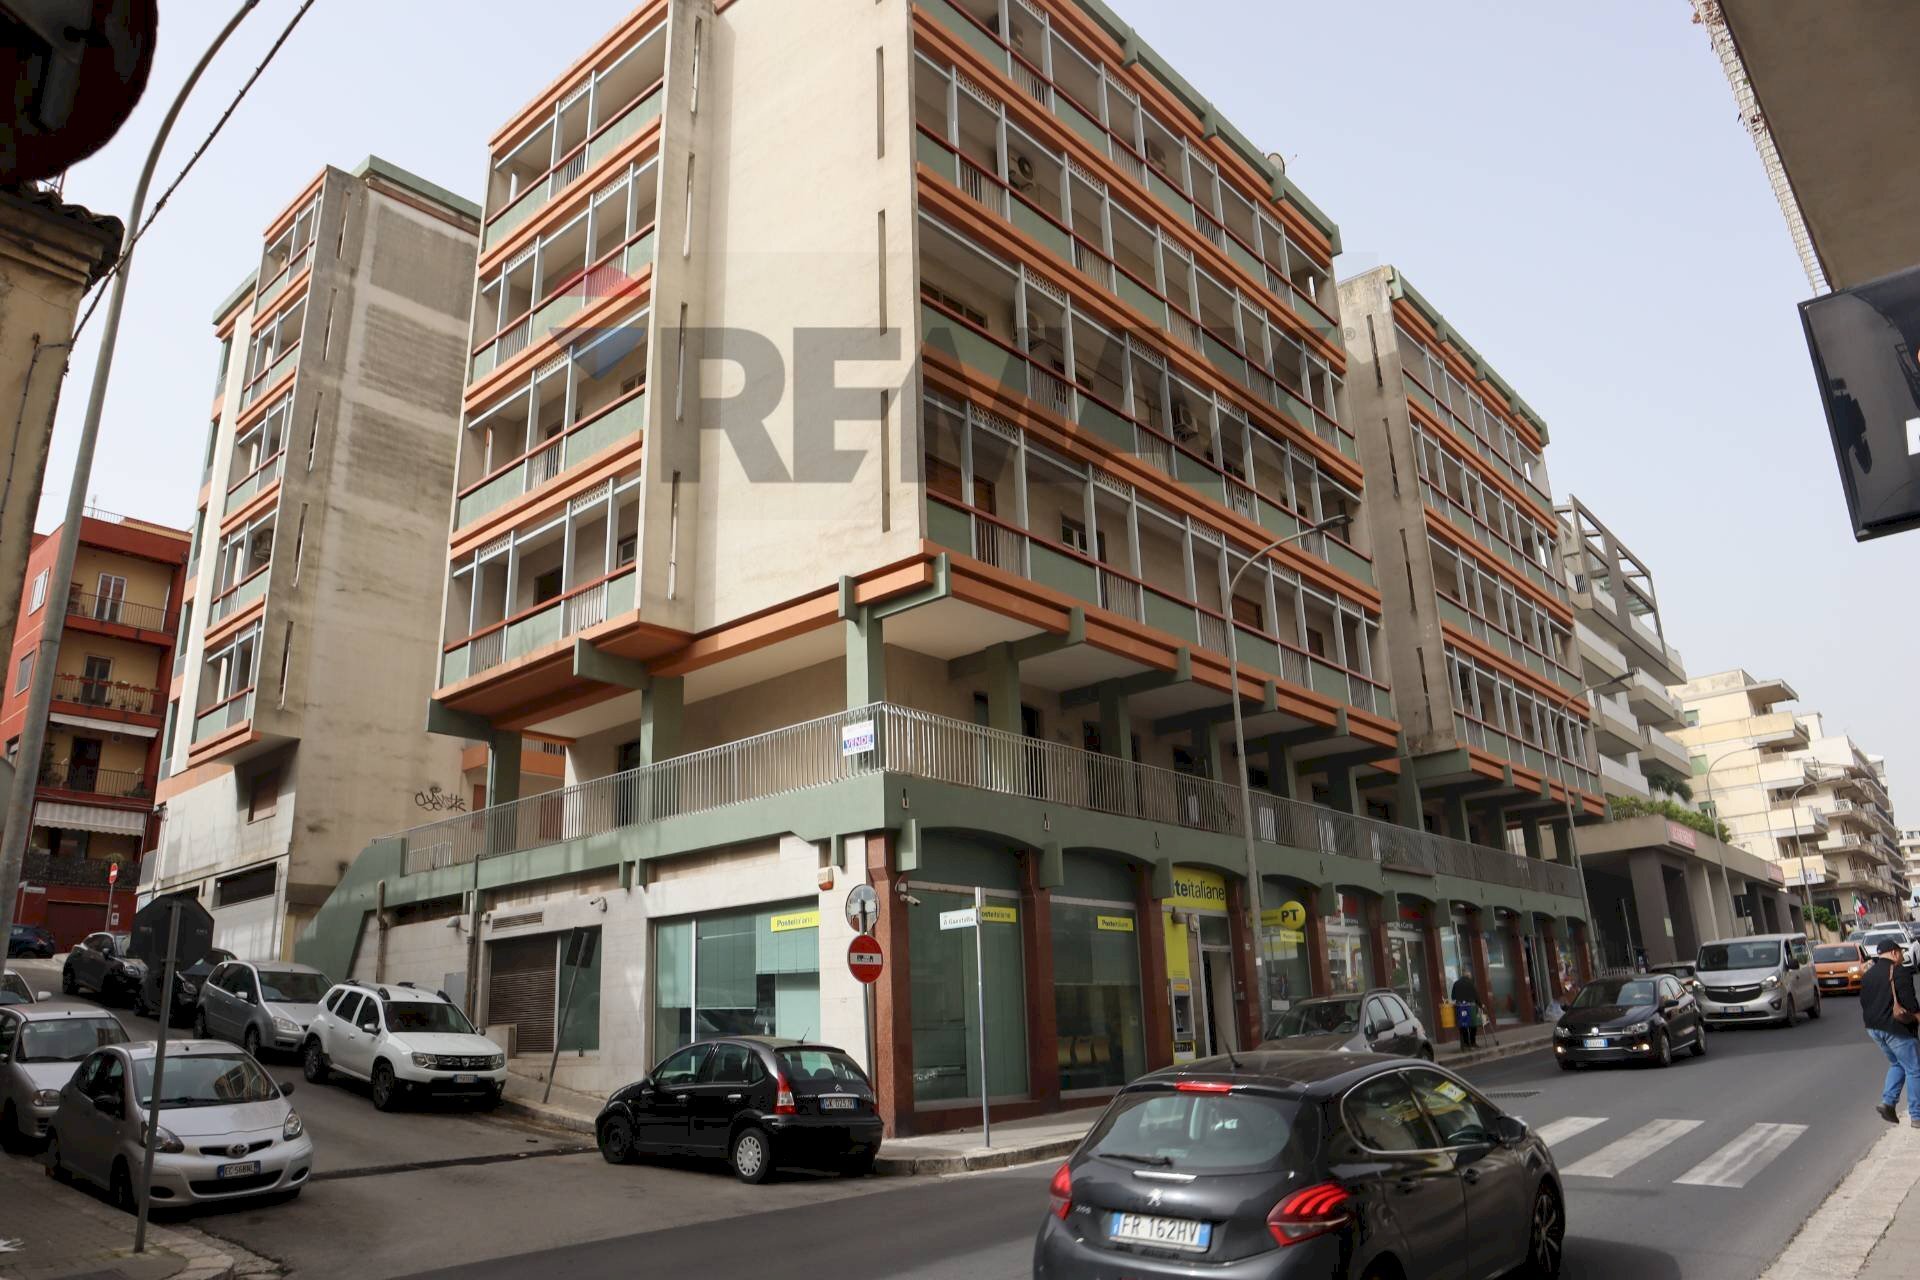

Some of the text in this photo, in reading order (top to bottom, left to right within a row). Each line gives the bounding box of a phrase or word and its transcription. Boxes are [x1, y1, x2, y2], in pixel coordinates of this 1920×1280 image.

[1281, 909, 1299, 922] PT
[1121, 1213, 1199, 1242] FR 162HV
